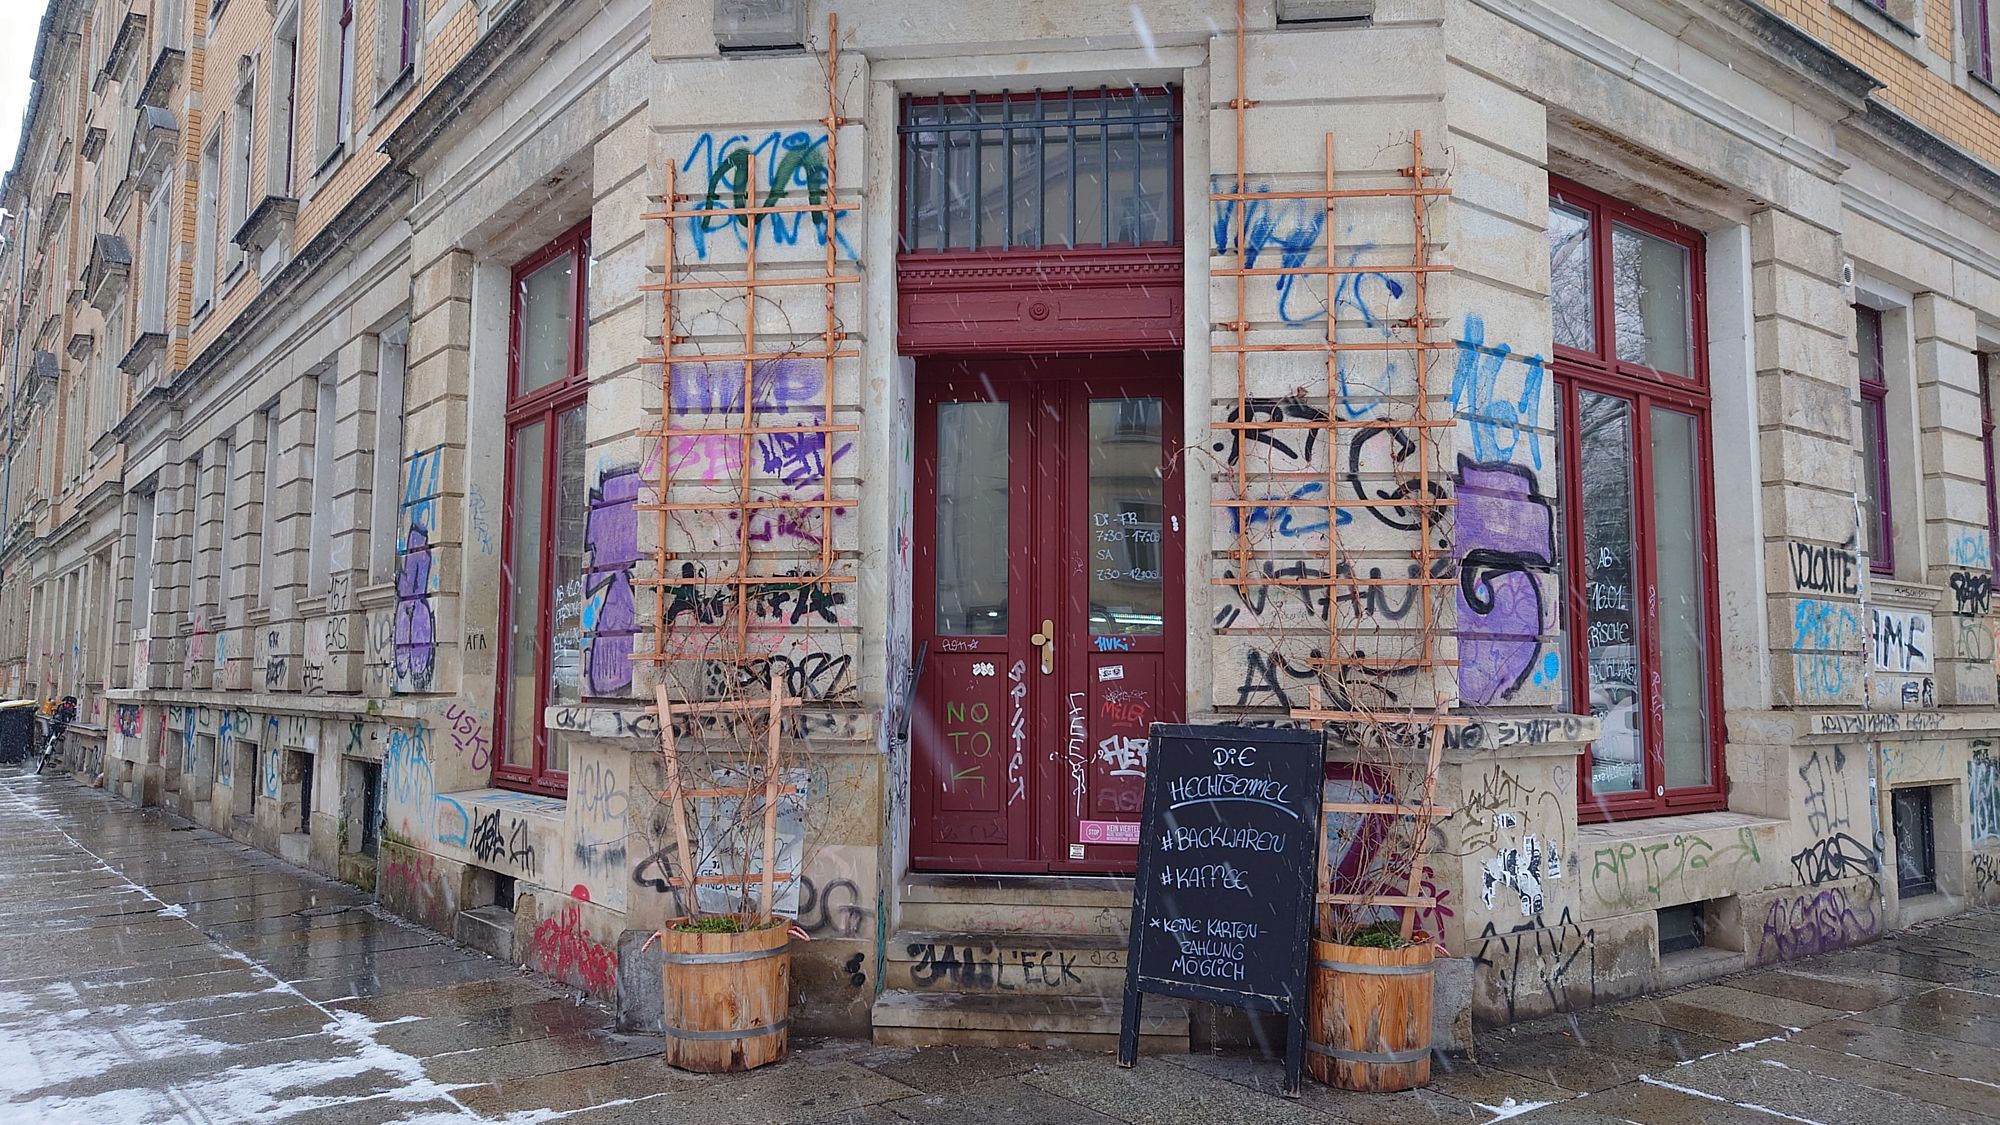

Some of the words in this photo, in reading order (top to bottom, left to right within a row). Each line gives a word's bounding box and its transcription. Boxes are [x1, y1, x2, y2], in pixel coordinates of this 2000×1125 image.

[1096, 549, 1114, 560] SA
[947, 701, 989, 724] NO
[1170, 774, 1292, 803] HECHTSEMMEL
[1160, 826, 1287, 853] #BACKWAREN
[1160, 864, 1250, 890] #KAFFEE
[1180, 940, 1245, 960] ZAHLUNG
